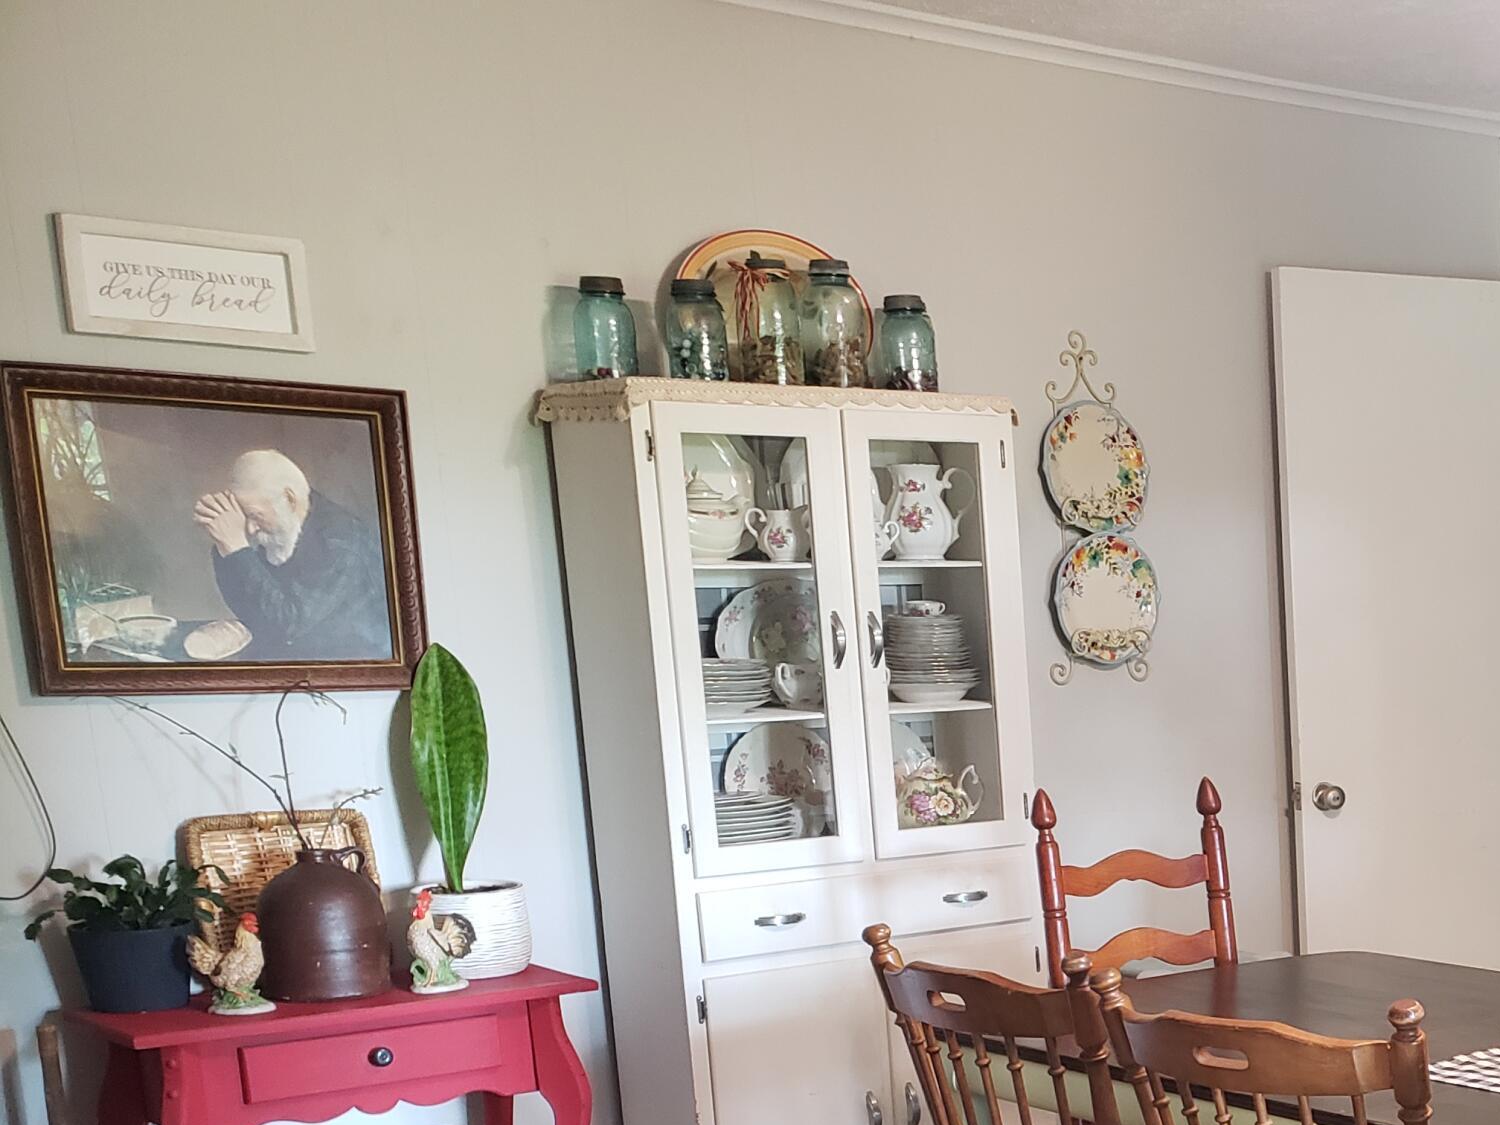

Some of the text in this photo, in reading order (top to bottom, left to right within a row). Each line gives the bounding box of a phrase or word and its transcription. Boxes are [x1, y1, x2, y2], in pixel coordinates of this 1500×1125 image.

[102, 261, 273, 290] GIVE US THIS DAY OUR
[98, 273, 275, 317] daily bread
